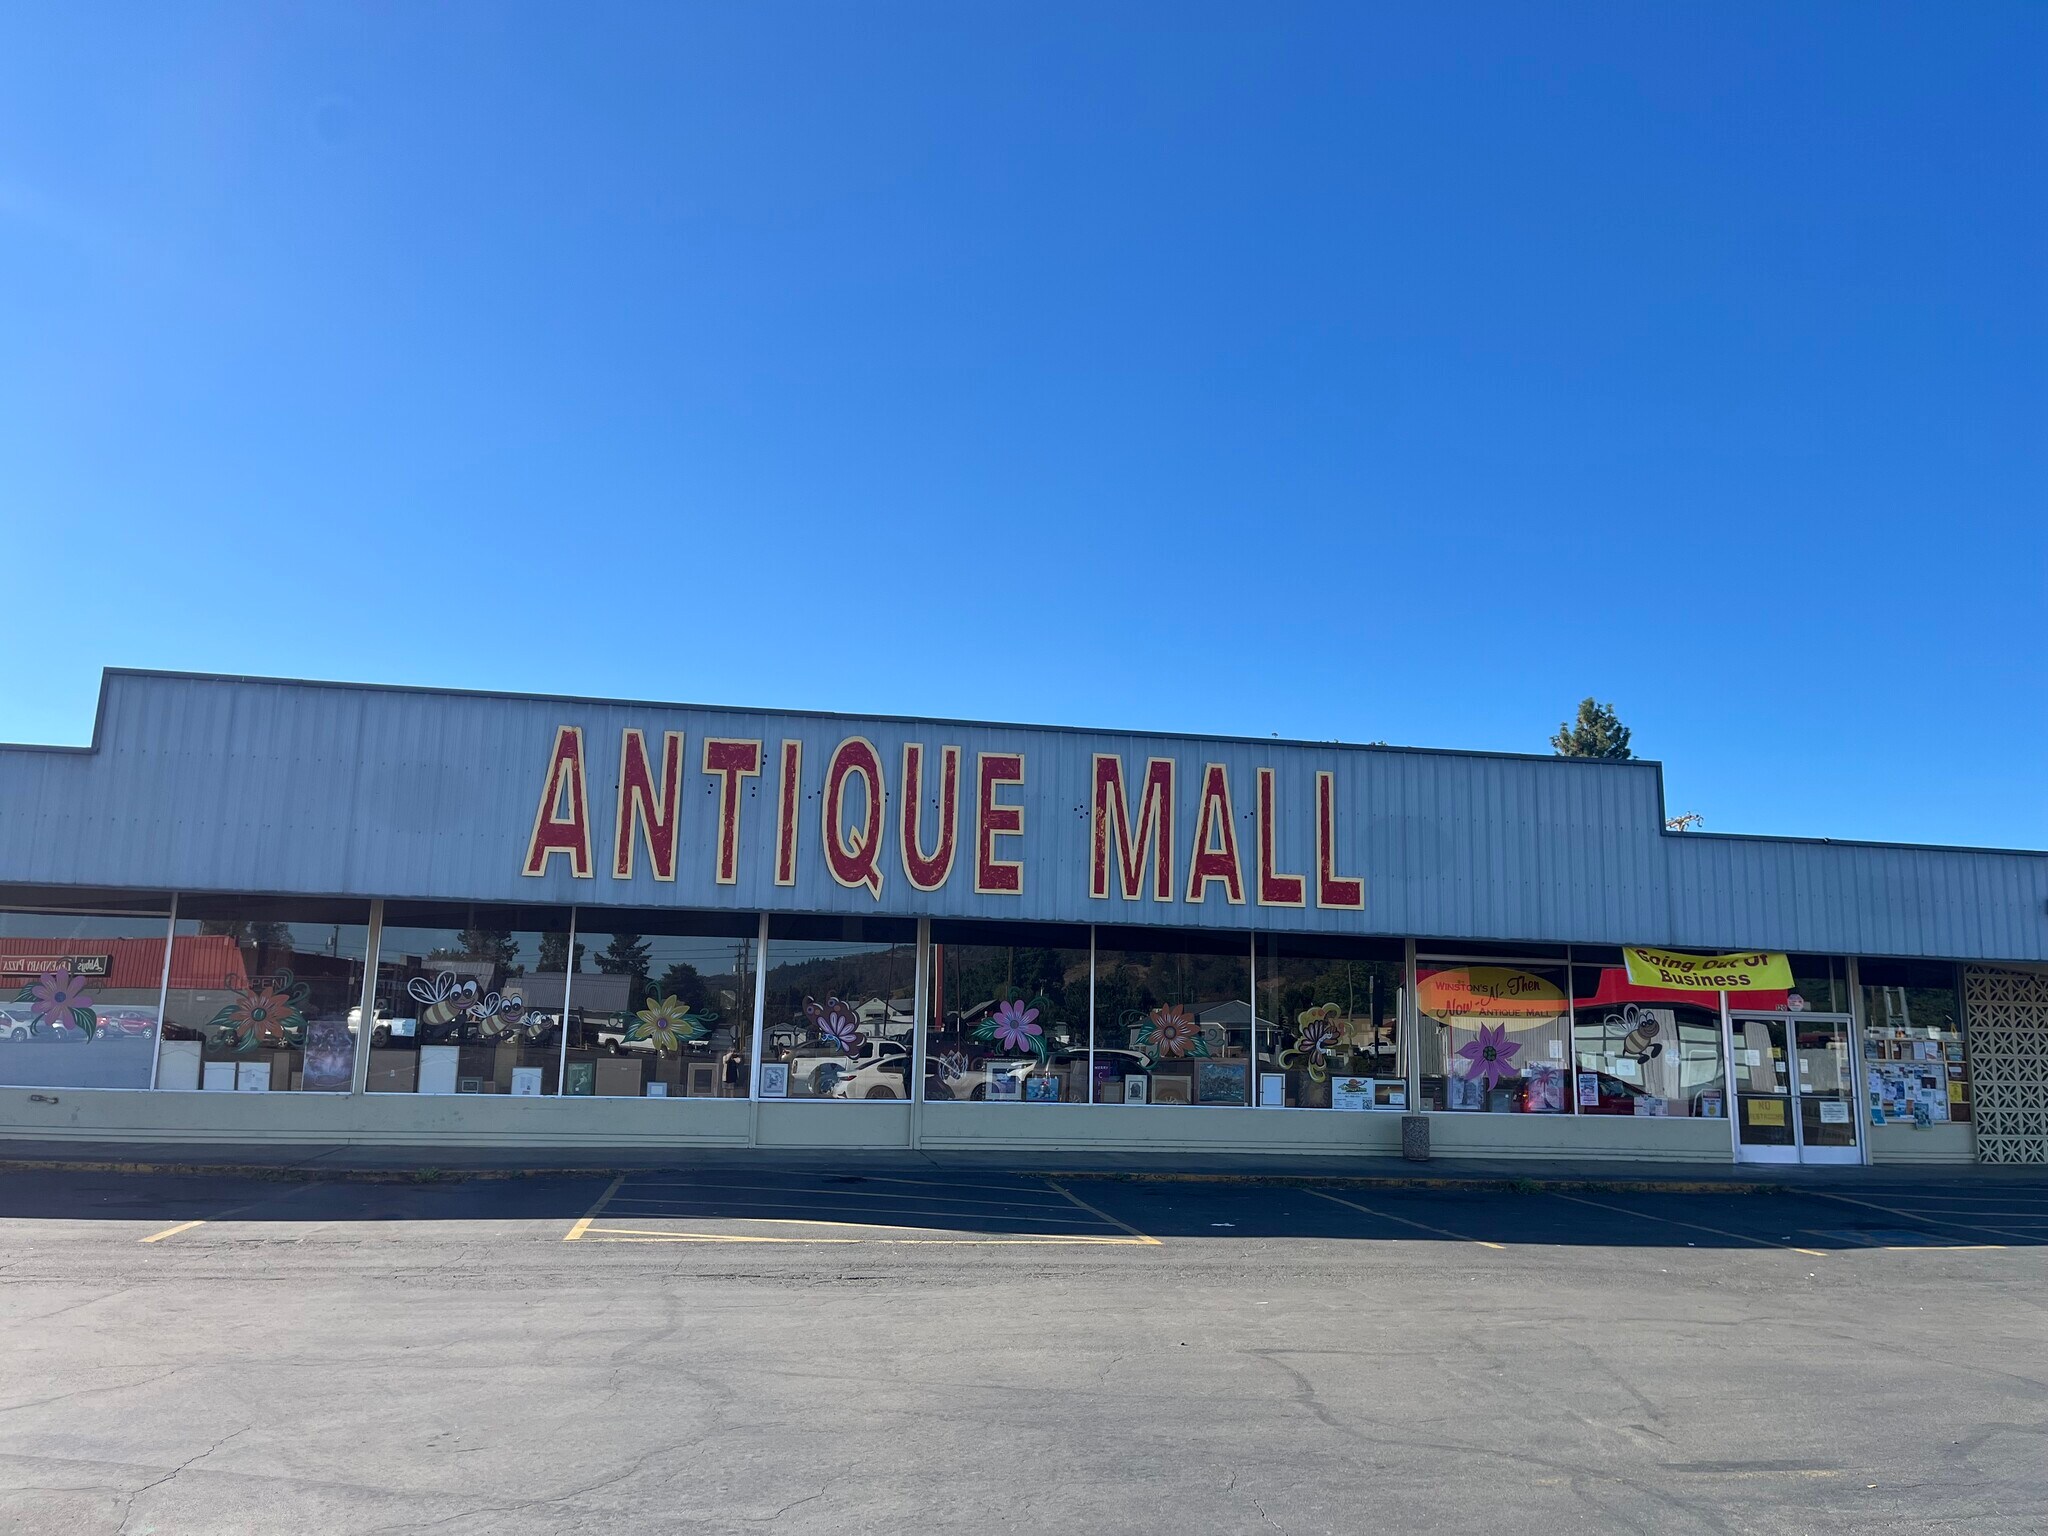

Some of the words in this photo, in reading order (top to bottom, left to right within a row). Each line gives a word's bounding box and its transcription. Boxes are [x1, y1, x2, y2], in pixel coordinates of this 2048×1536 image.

[522, 725, 1025, 901] ANTIQUE
[1089, 752, 1365, 910] MALL
[1636, 949, 1697, 972] Going
[1702, 959, 1739, 970] Out
[1659, 969, 1751, 987] Business
[1435, 981, 1489, 993] WINSTON'S
[1479, 1007, 1522, 1017] ANTIQUE
[1526, 1008, 1552, 1018] MALL
[1757, 1100, 1771, 1111] NO
